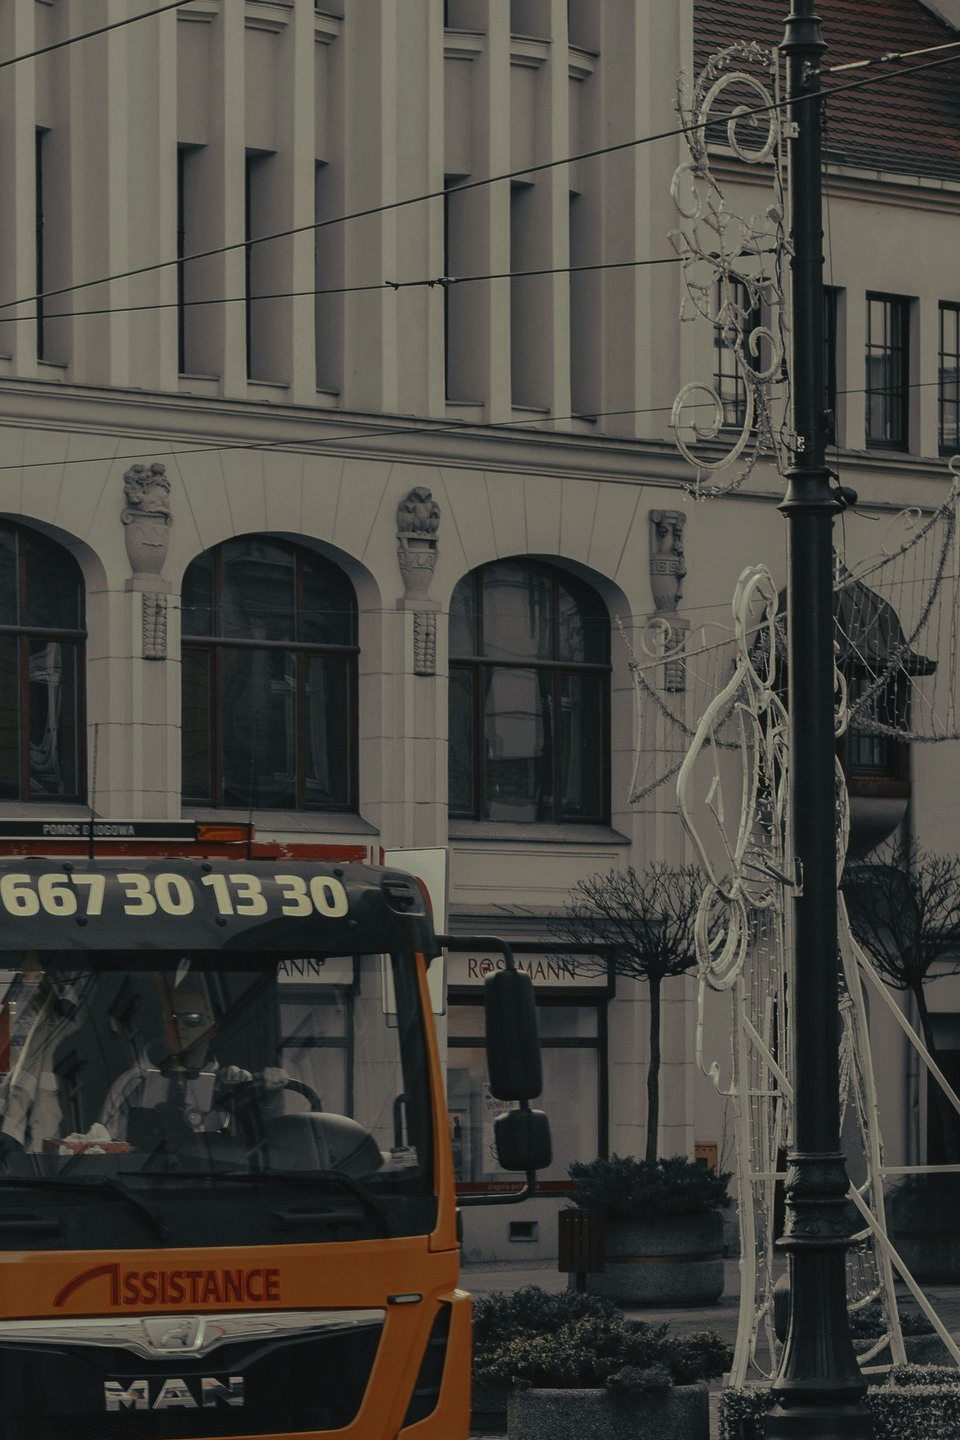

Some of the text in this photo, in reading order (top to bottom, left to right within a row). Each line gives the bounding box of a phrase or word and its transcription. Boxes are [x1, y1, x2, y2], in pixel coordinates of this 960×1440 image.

[43, 824, 81, 836] POMOC
[0, 873, 349, 918] 667 30 13 30
[468, 958, 576, 981] ROSMANN
[53, 1263, 280, 1307] ASSISTANCE
[103, 1376, 244, 1411] MAN
